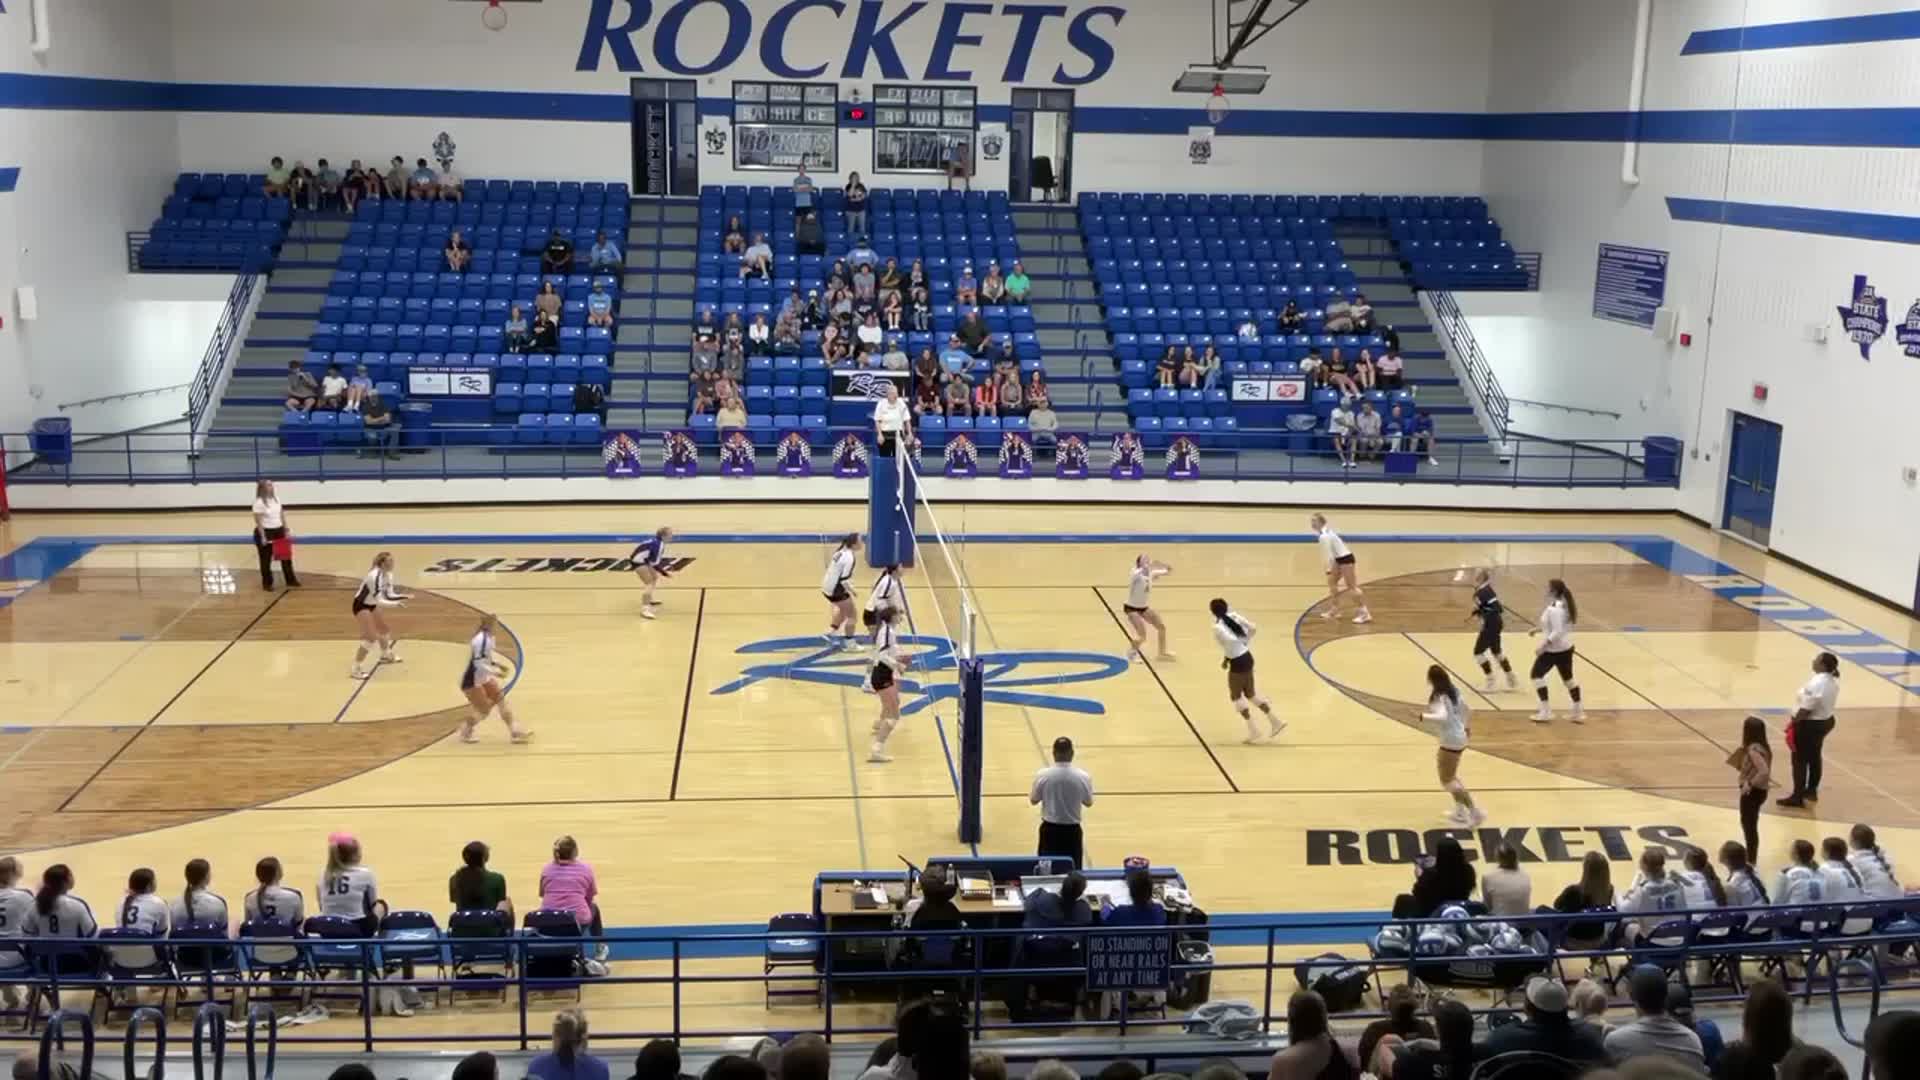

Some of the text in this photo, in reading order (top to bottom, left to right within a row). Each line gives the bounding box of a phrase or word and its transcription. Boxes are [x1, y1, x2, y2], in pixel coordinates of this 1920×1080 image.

[576, 0, 1126, 85] ROCKETS
[326, 876, 351, 895] 16
[1090, 936, 1168, 952] NO STANDING ON
[1092, 953, 1166, 968] OR NEAR RAILS
[1097, 970, 1160, 985] AT ANY TIME
